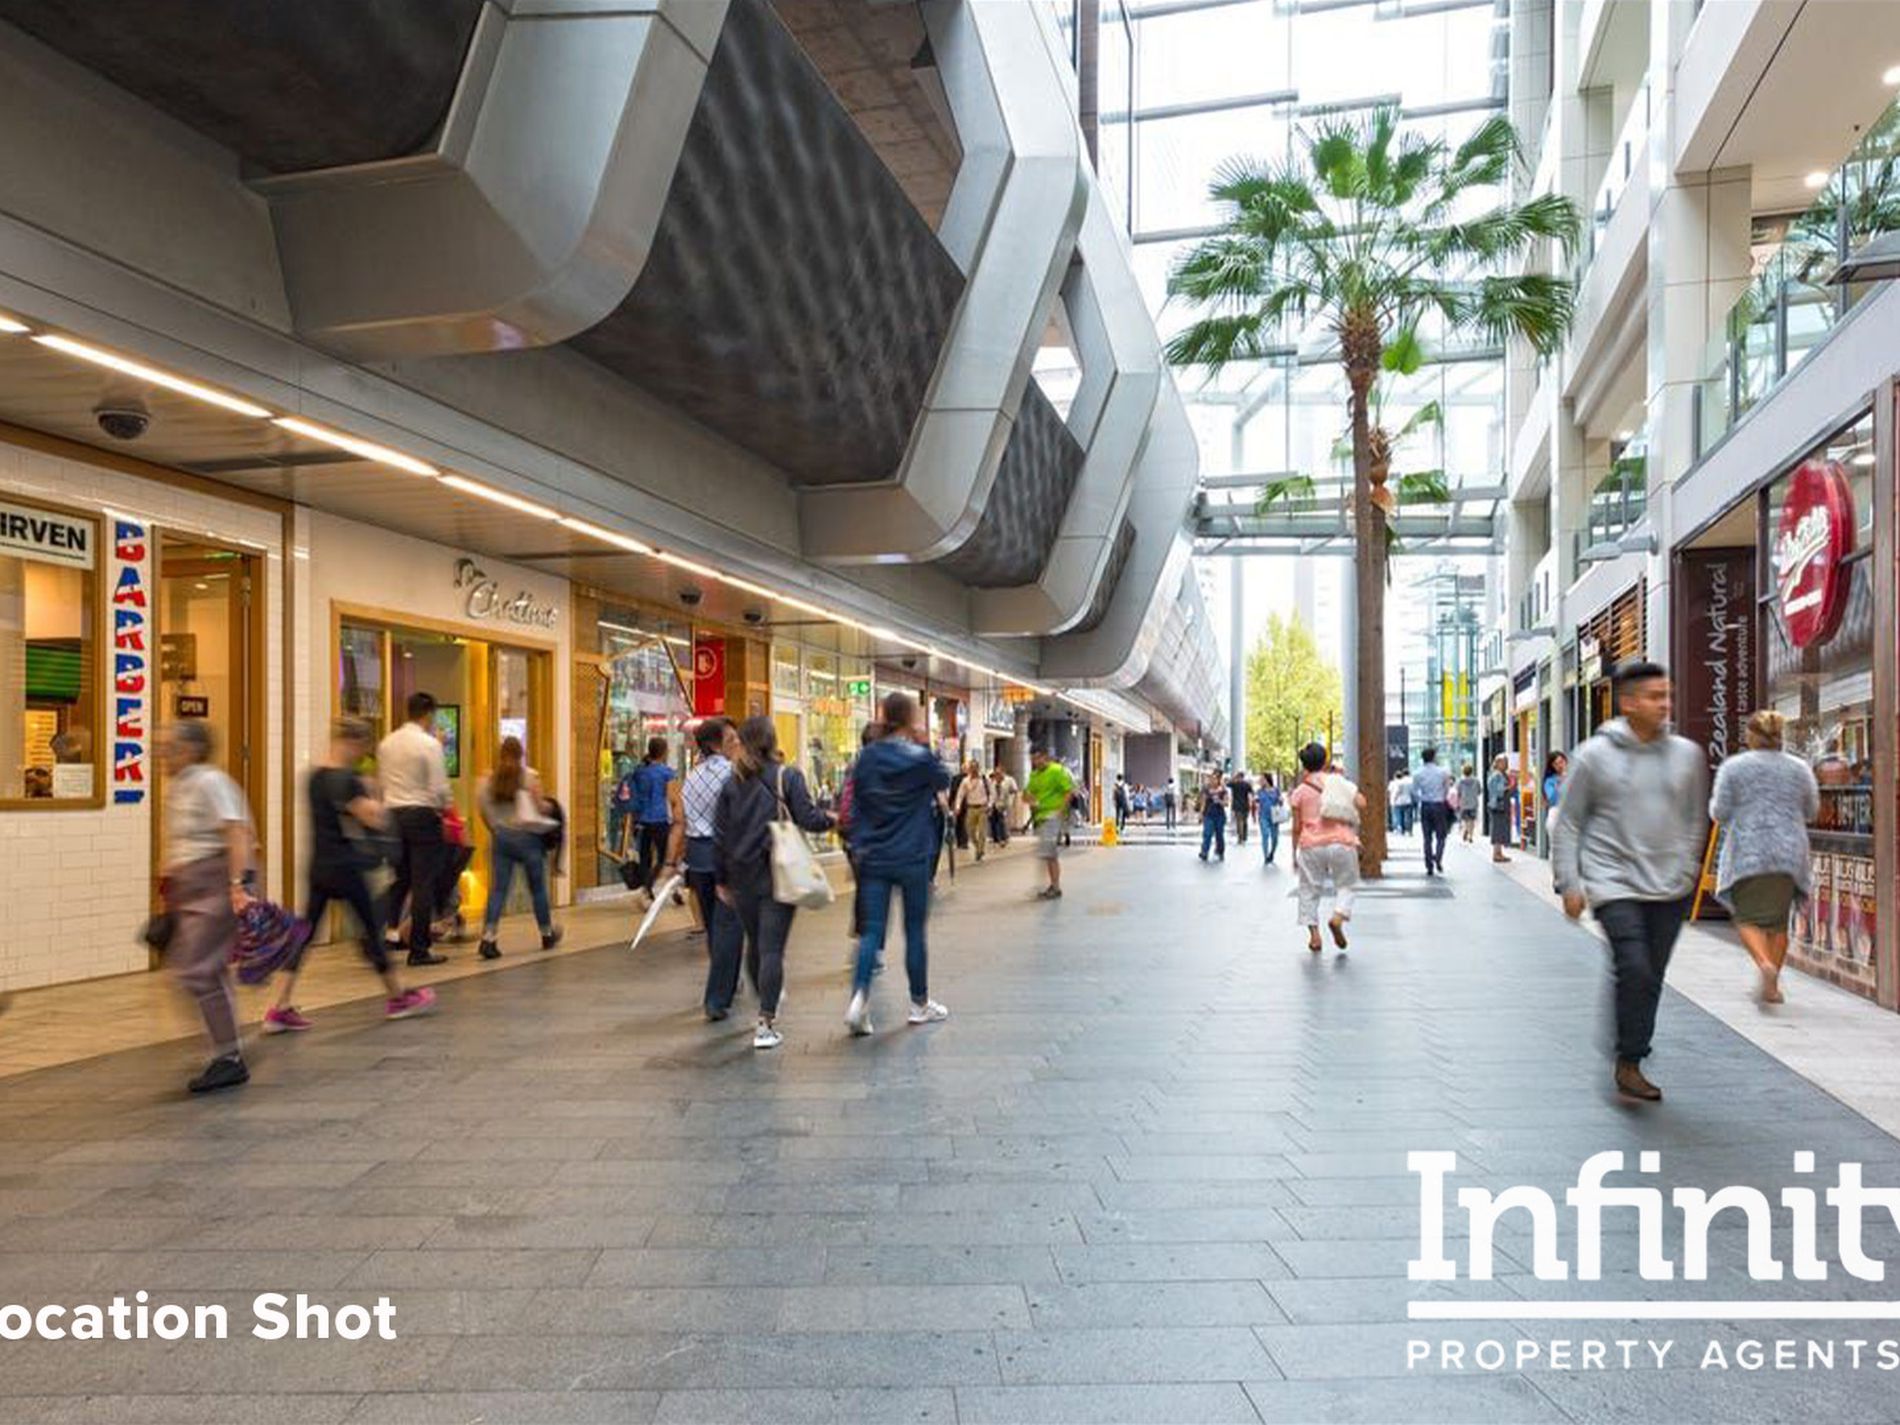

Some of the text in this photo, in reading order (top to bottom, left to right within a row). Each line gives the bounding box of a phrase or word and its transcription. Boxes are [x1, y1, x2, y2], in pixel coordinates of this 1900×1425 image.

[113, 521, 146, 782] BARBER
[1706, 562, 1728, 653] Natural
[1736, 615, 1748, 678] adventure
[1704, 660, 1728, 759] Zealand
[1736, 681, 1748, 712] taste
